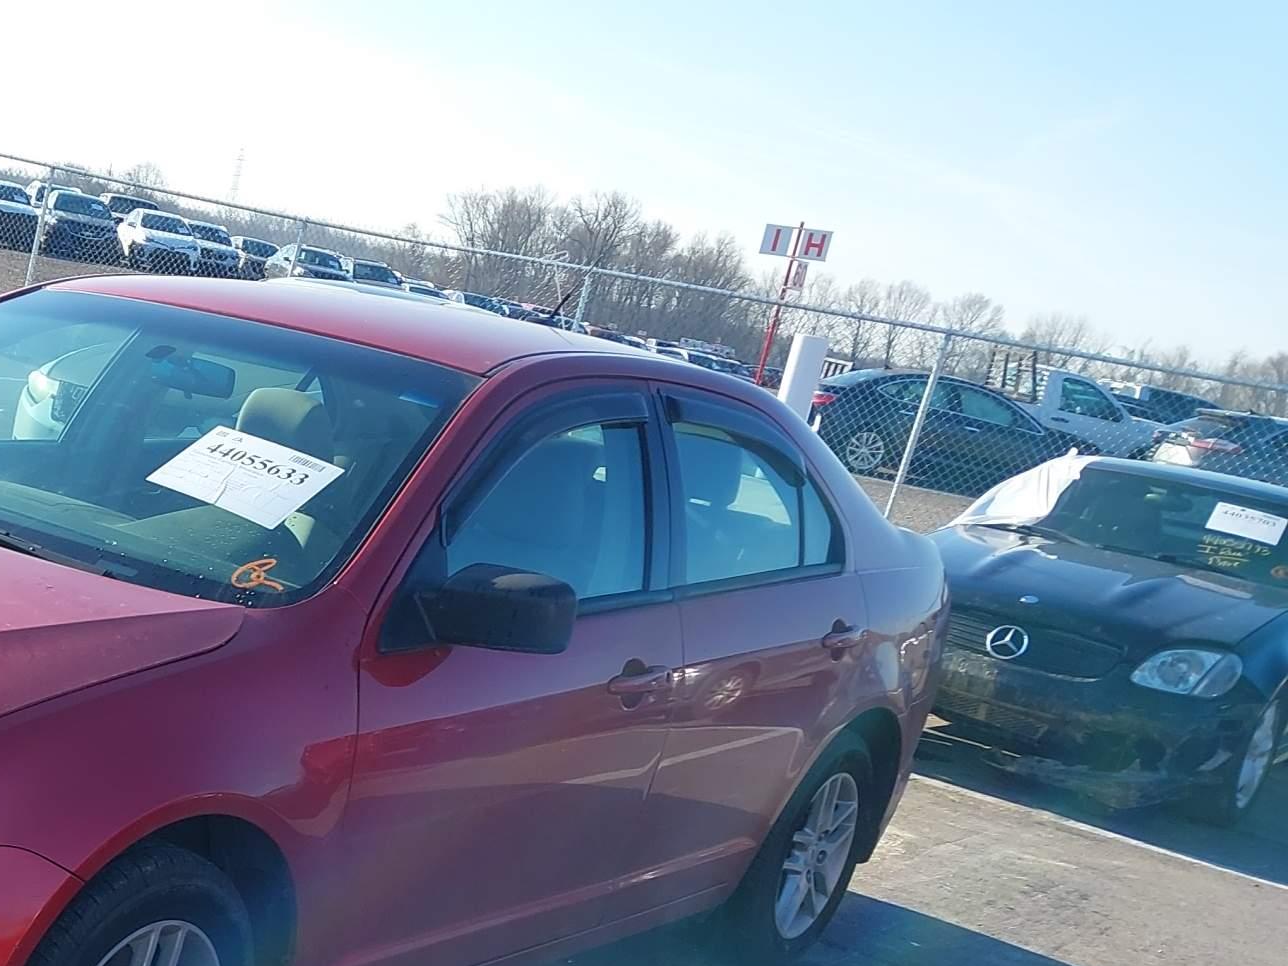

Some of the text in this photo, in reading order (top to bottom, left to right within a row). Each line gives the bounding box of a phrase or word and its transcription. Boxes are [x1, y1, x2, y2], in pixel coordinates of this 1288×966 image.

[770, 228, 827, 257] I H
[206, 443, 310, 486] 44055633
